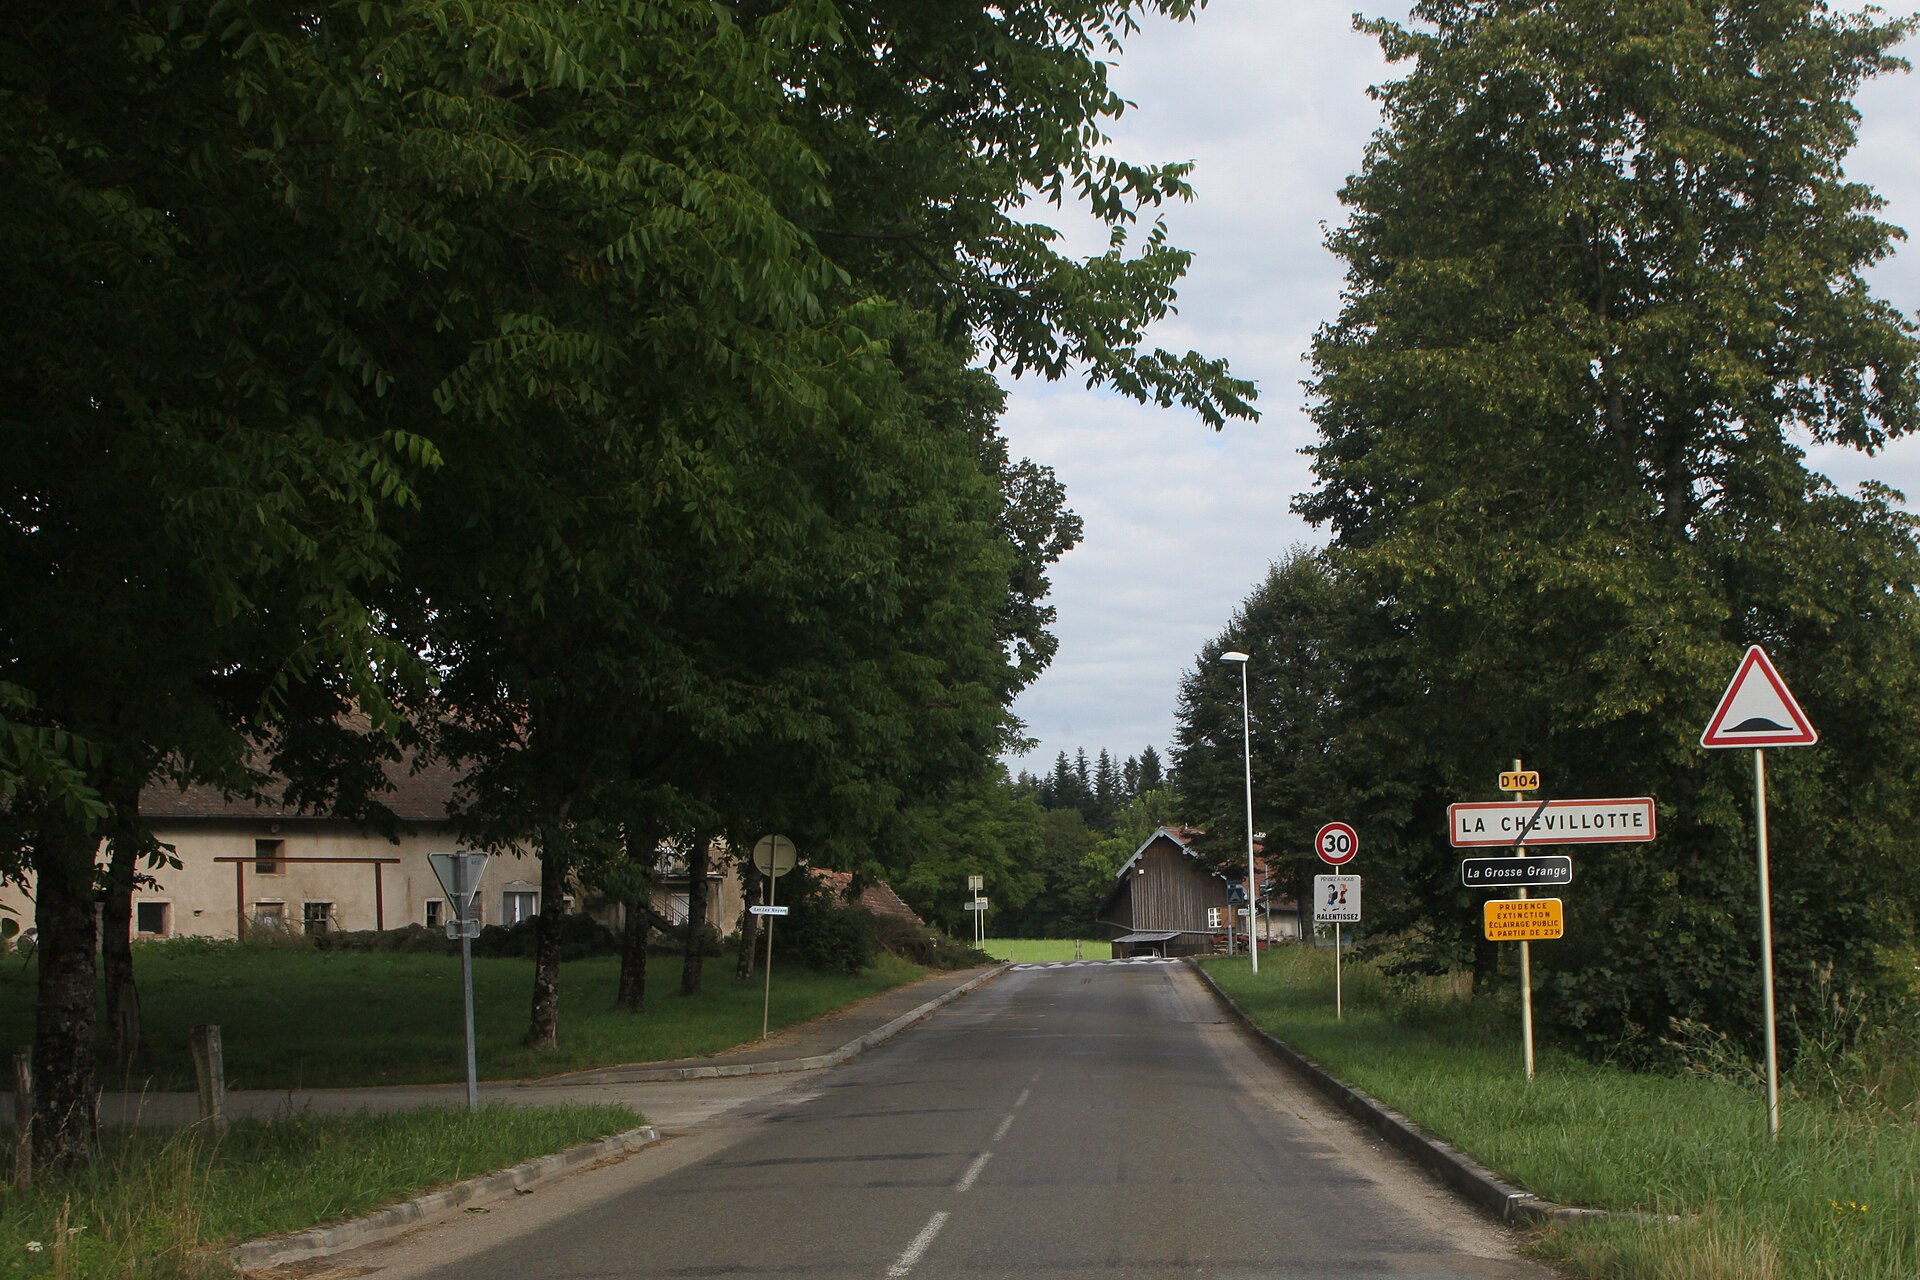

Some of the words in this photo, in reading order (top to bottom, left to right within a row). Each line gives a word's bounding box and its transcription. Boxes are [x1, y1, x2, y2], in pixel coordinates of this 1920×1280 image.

[1501, 776, 1509, 787] D
[1513, 775, 1537, 787] 104
[1462, 818, 1485, 833] LA
[1501, 812, 1643, 831] CHEVILLOTTE
[1324, 834, 1350, 853] 30
[1467, 867, 1480, 878] La
[1484, 867, 1523, 878] Grosse
[1527, 865, 1567, 877] Grange
[1497, 911, 1550, 919] EXTINCTION
[1489, 921, 1530, 929] ÉCLAIRAGE
